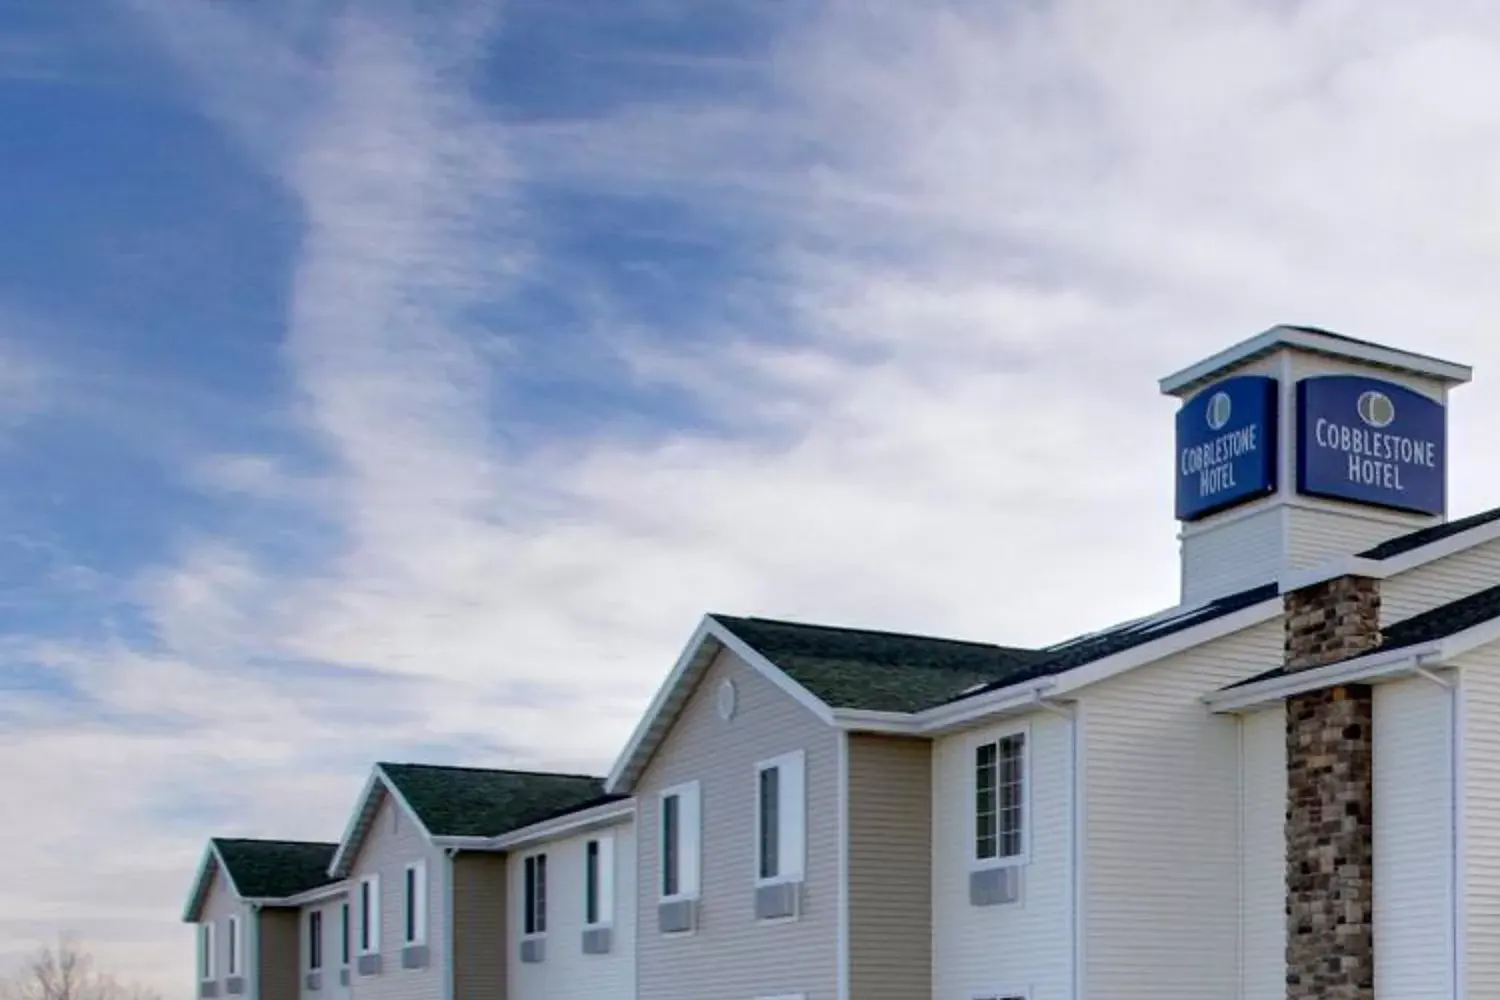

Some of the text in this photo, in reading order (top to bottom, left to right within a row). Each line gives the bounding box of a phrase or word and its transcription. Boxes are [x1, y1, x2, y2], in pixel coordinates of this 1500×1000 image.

[1181, 424, 1257, 476] COBBLESTONE
[1315, 417, 1436, 468] COBBLESTONE
[1200, 461, 1237, 498] HOTEL
[1349, 454, 1405, 491] HOTEL
